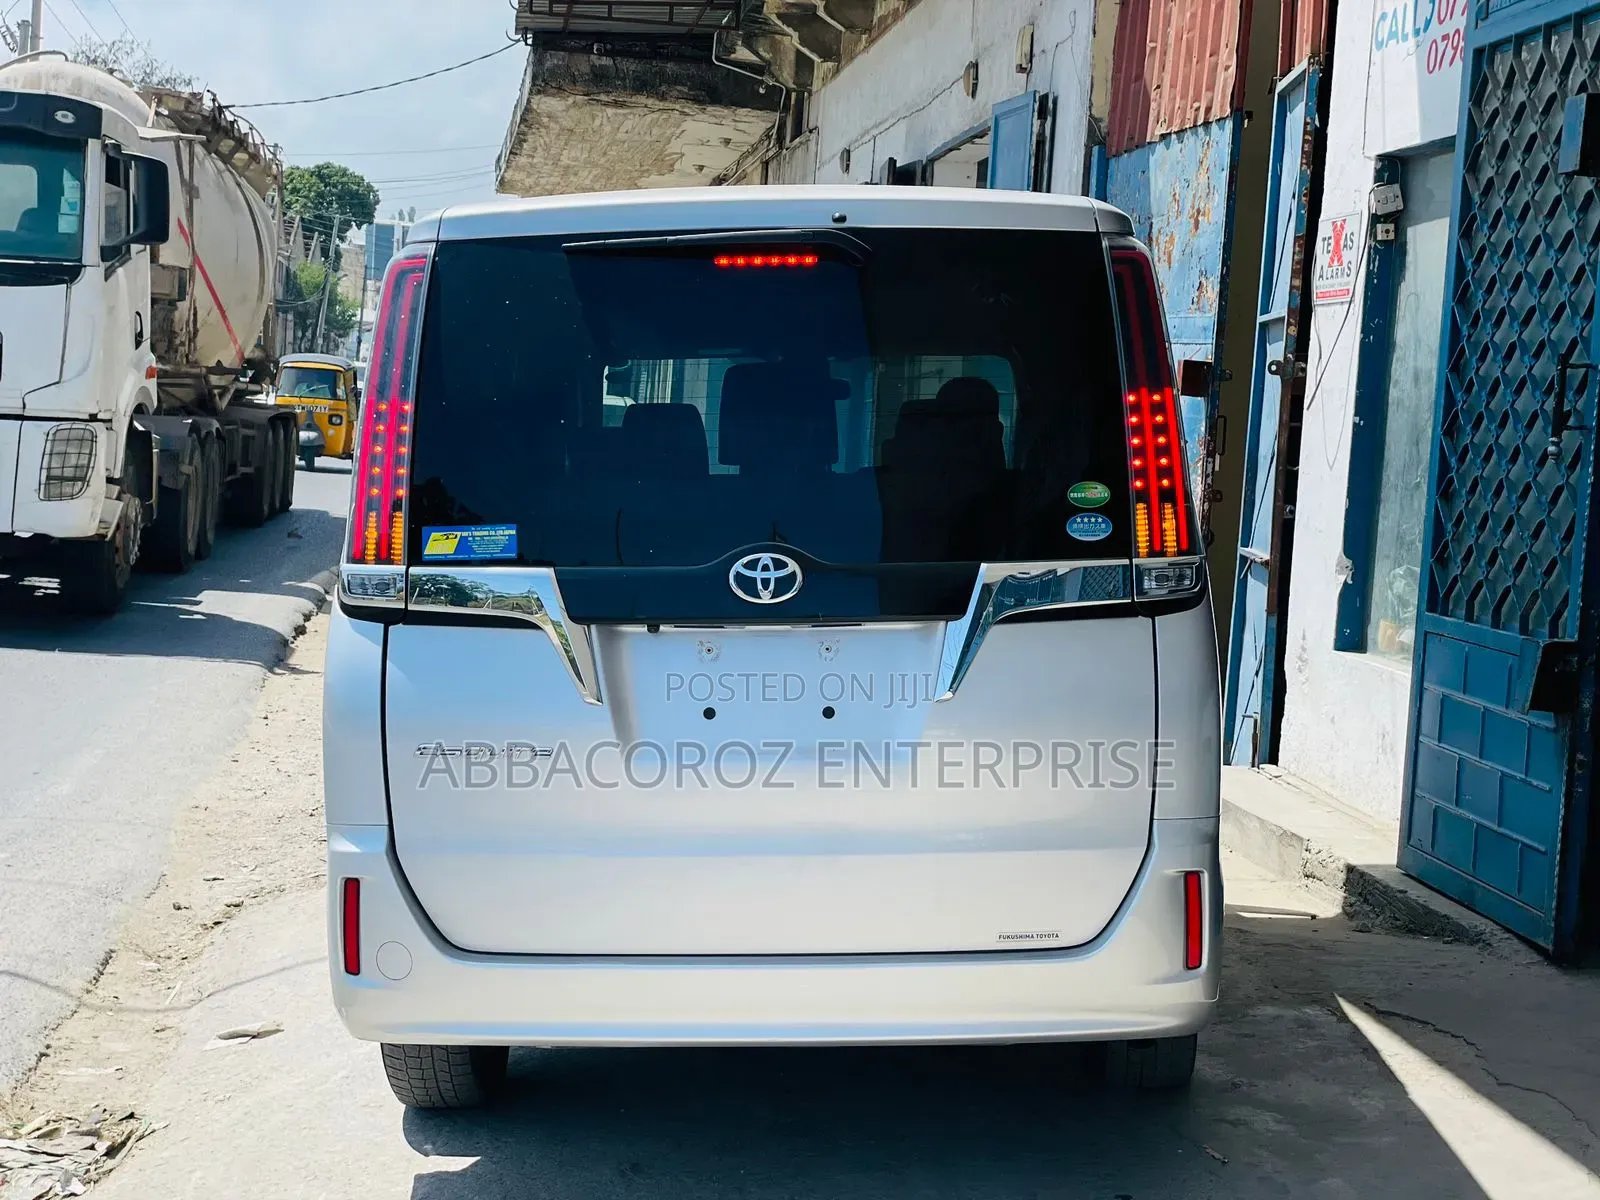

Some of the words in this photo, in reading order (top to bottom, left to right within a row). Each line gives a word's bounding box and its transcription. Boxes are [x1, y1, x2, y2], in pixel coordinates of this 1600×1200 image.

[1374, 0, 1421, 51] CALL
[1320, 218, 1355, 268] TEXAS
[1317, 261, 1352, 281] ALARMS
